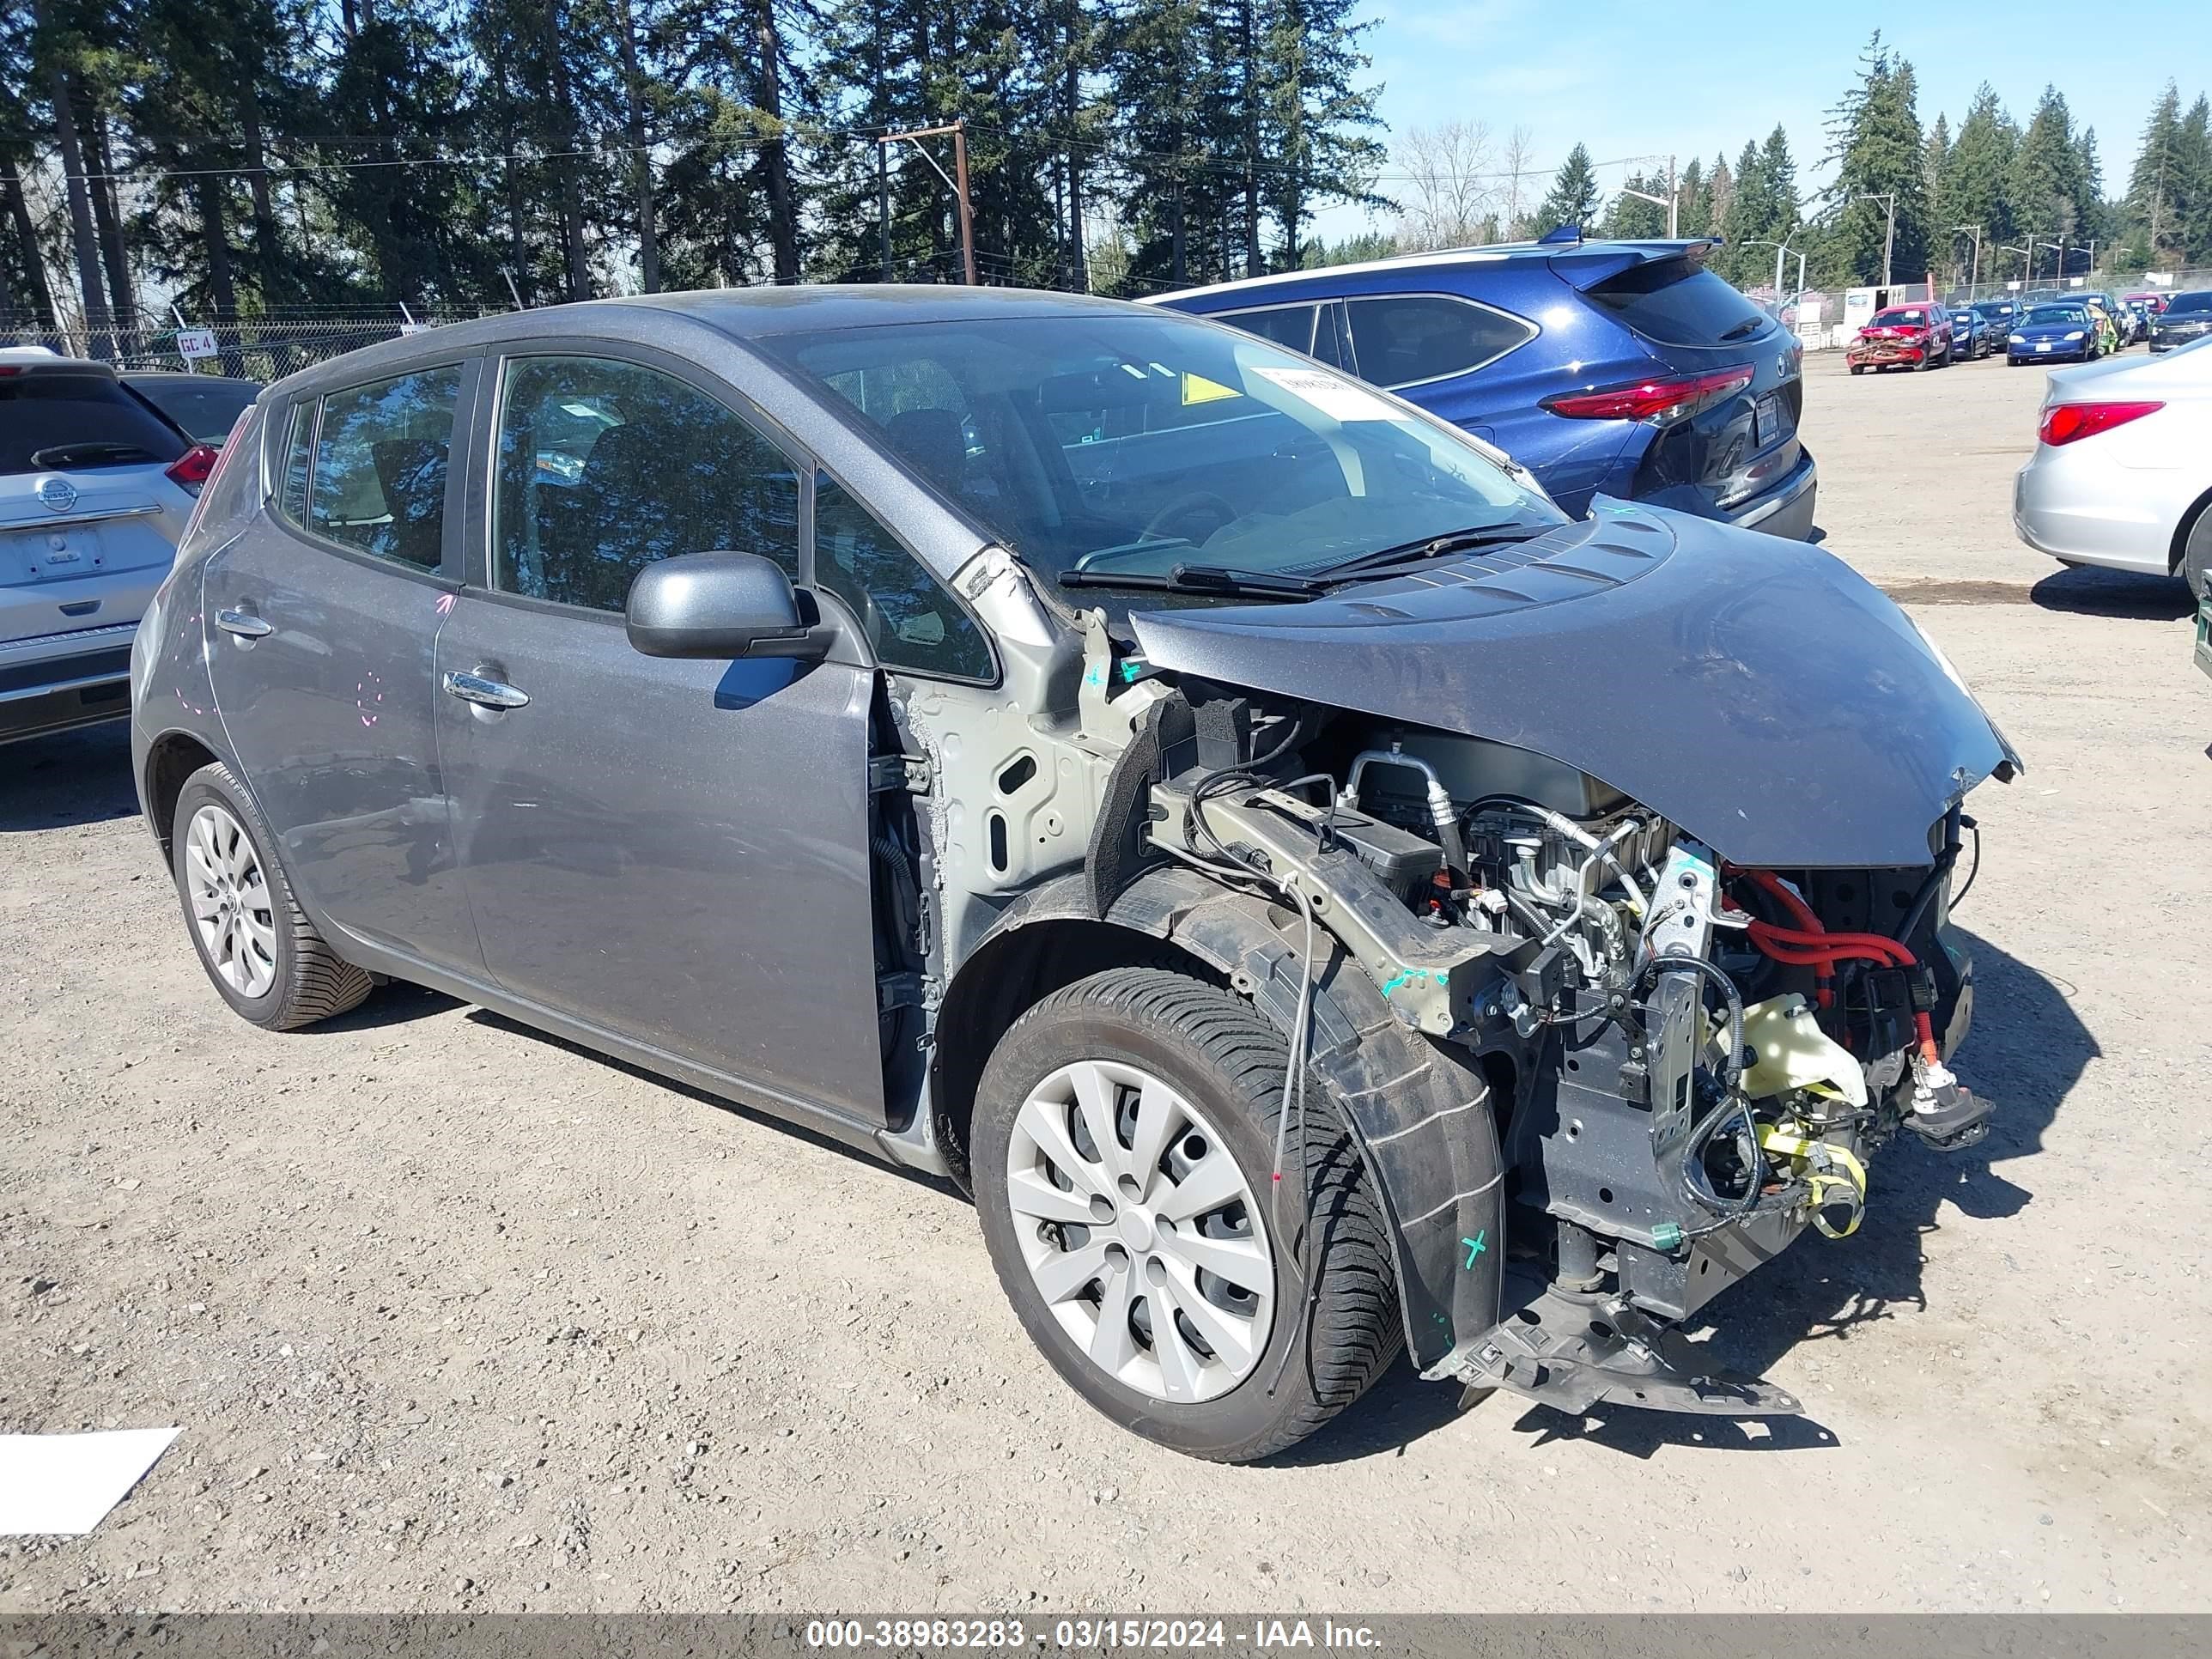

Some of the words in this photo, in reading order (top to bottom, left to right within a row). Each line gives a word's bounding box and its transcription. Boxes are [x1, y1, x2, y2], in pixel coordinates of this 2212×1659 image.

[180, 337, 200, 353] GC
[203, 336, 211, 351] 4
[43, 491, 74, 500] NISSAN
